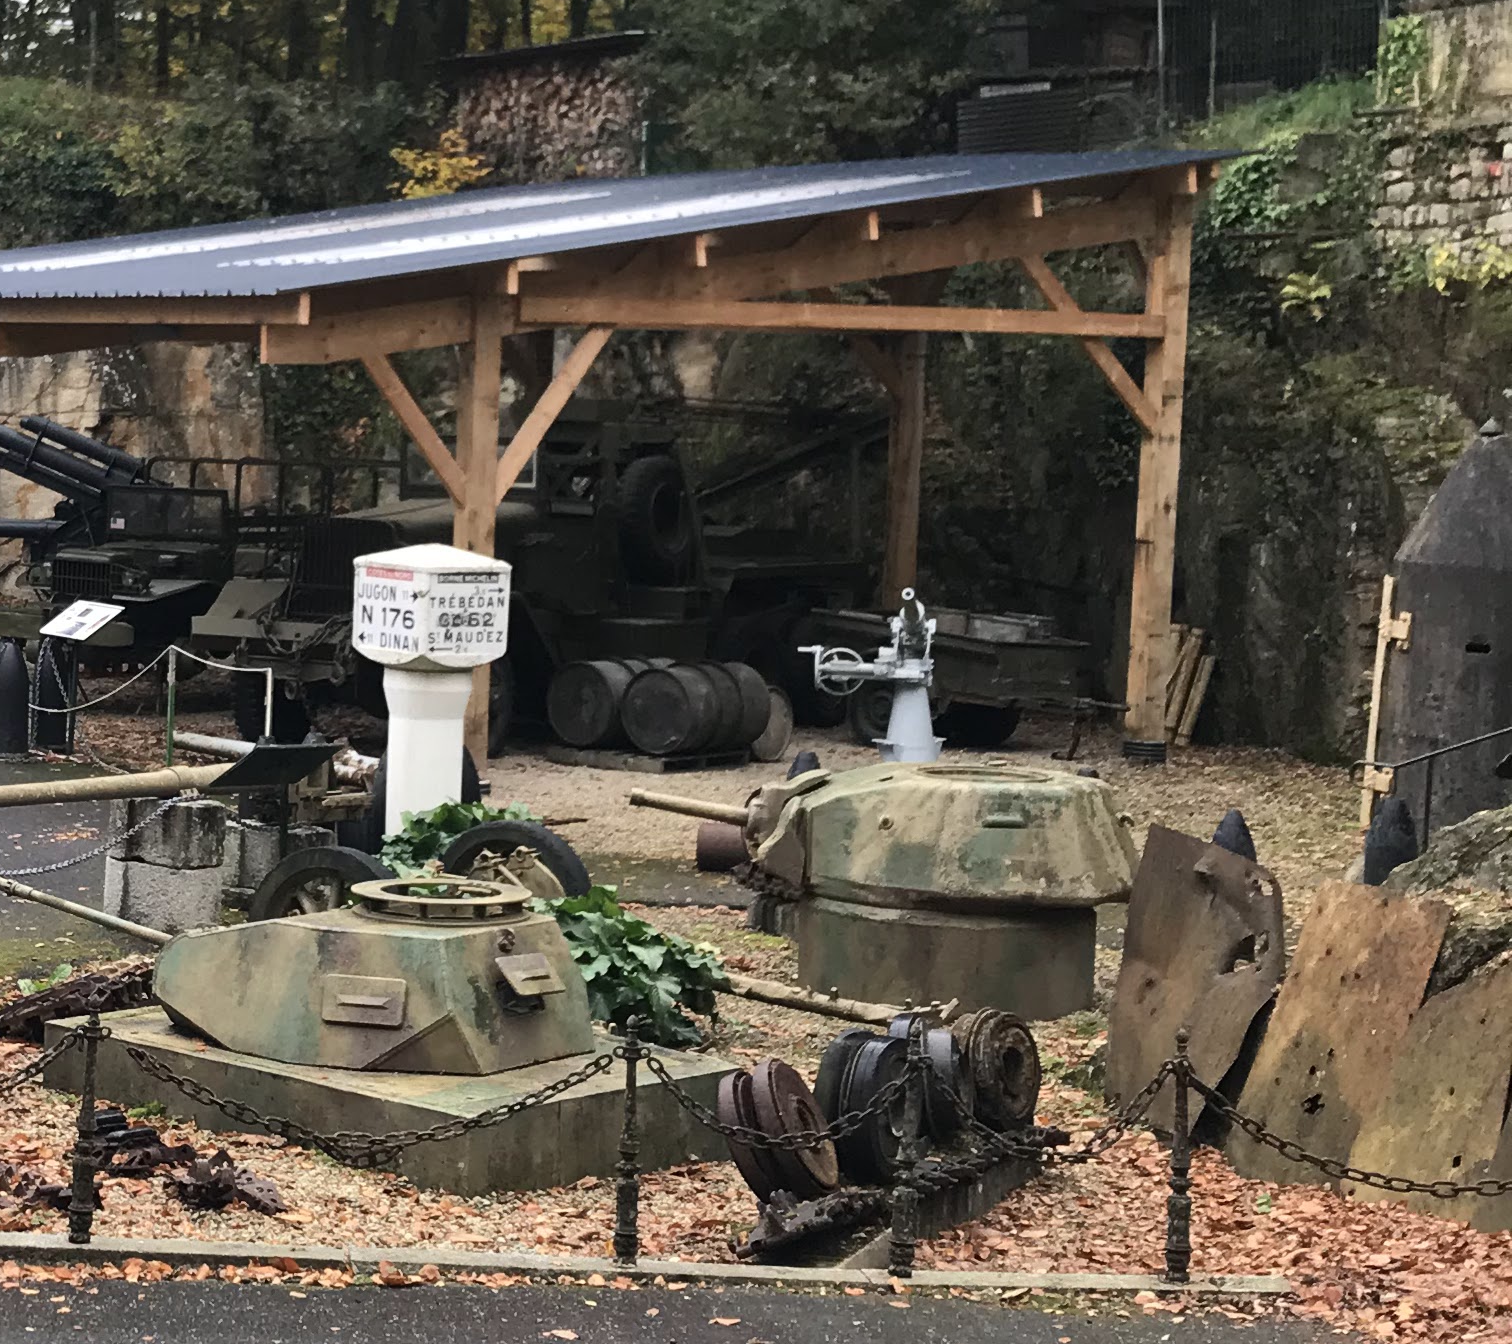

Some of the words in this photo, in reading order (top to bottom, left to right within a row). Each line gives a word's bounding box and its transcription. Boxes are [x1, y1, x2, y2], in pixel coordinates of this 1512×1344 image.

[358, 583, 397, 602] JUGON
[361, 605, 373, 624] N
[382, 607, 415, 629] 176
[380, 632, 419, 653] DINAN
